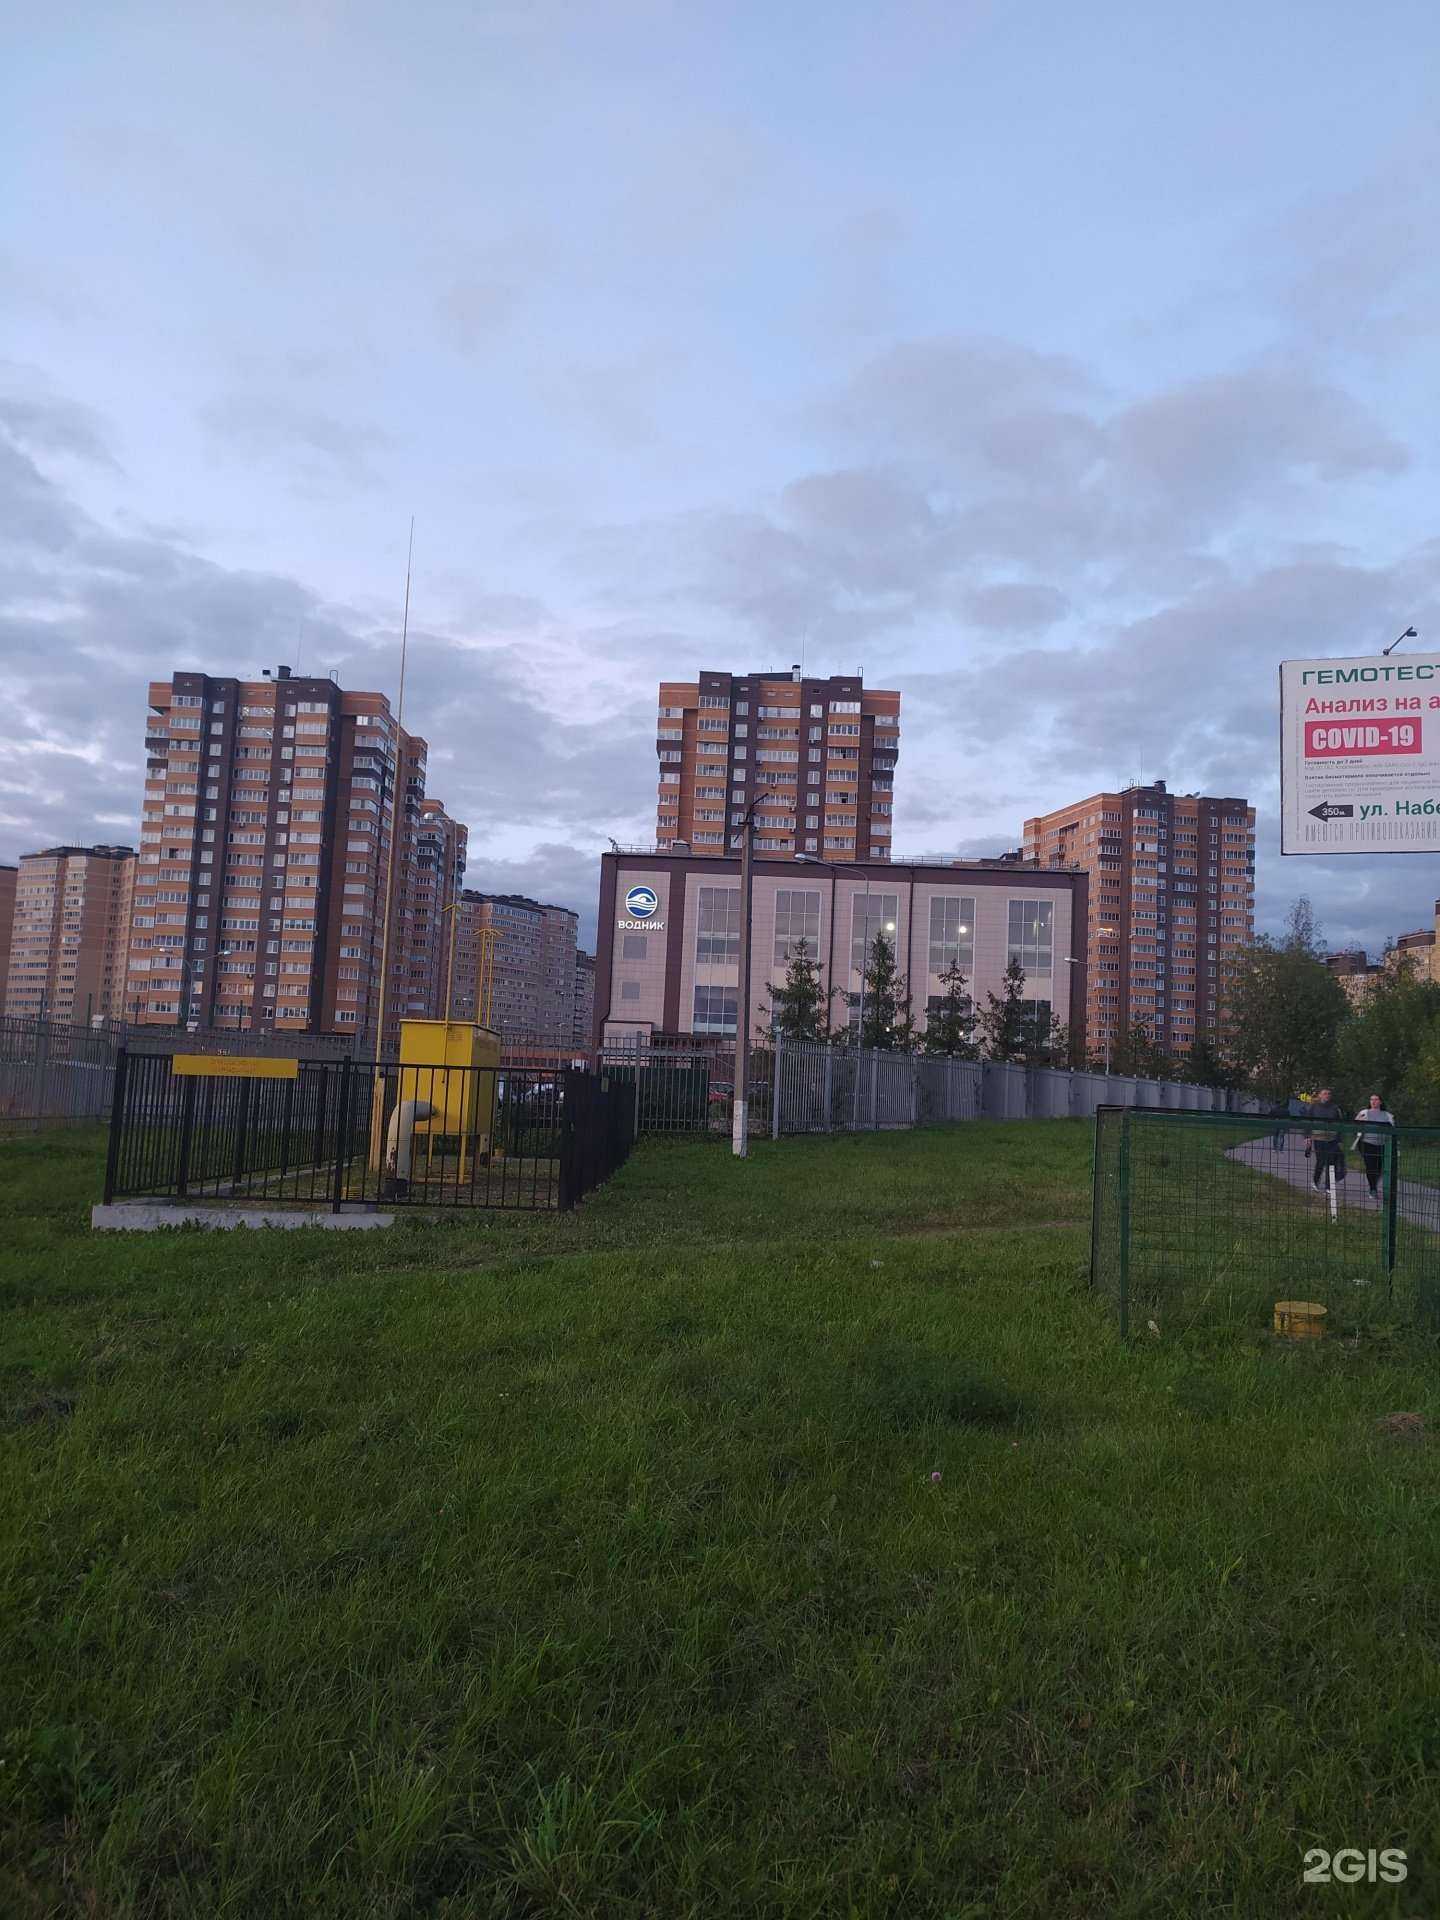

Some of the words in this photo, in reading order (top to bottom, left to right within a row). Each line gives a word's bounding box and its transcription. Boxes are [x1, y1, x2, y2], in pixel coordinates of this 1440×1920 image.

[1305, 697, 1388, 714] Анализ
[1395, 696, 1422, 711] на
[1312, 725, 1414, 750] COVID-19
[1360, 804, 1389, 820] ул.
[618, 920, 665, 931] ВОДНИК
